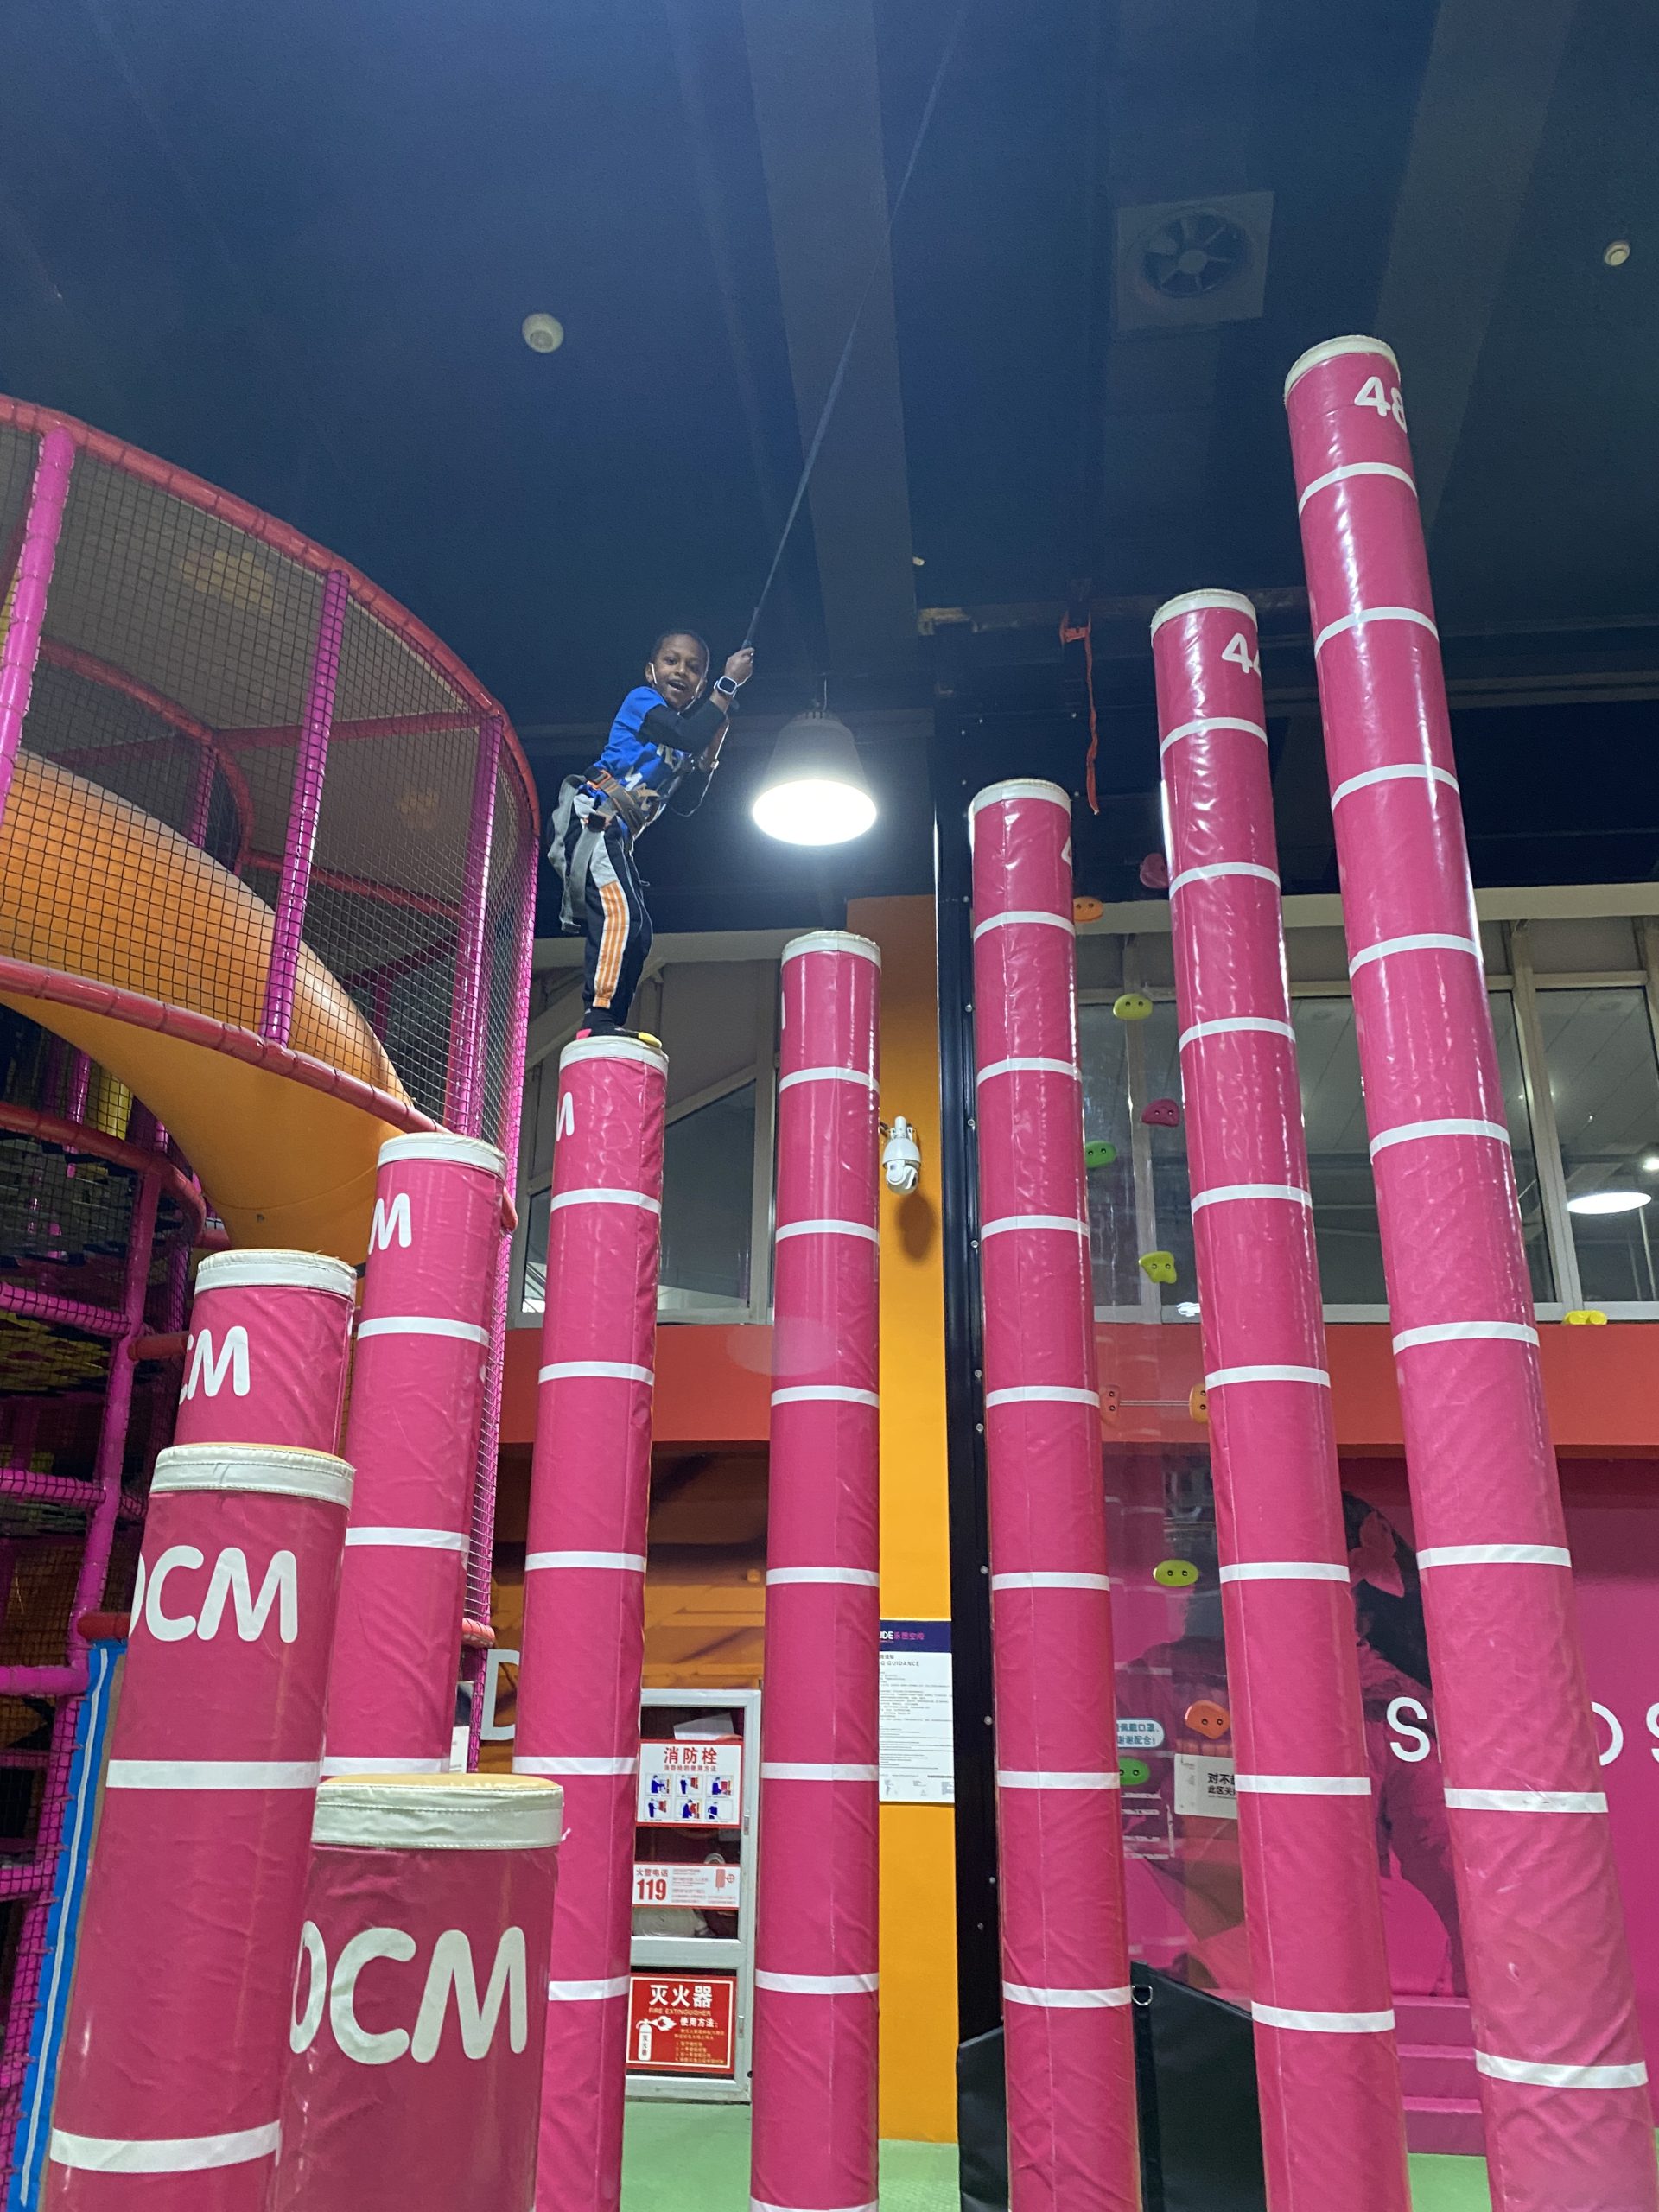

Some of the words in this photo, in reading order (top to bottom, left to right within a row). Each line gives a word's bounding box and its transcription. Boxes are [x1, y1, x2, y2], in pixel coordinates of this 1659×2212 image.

[664, 1746, 718, 1764] 消防栓
[637, 1878, 667, 1901] 119
[648, 1984, 713, 2009] 灭火器
[664, 2008, 712, 2017] EXTINGUISHER
